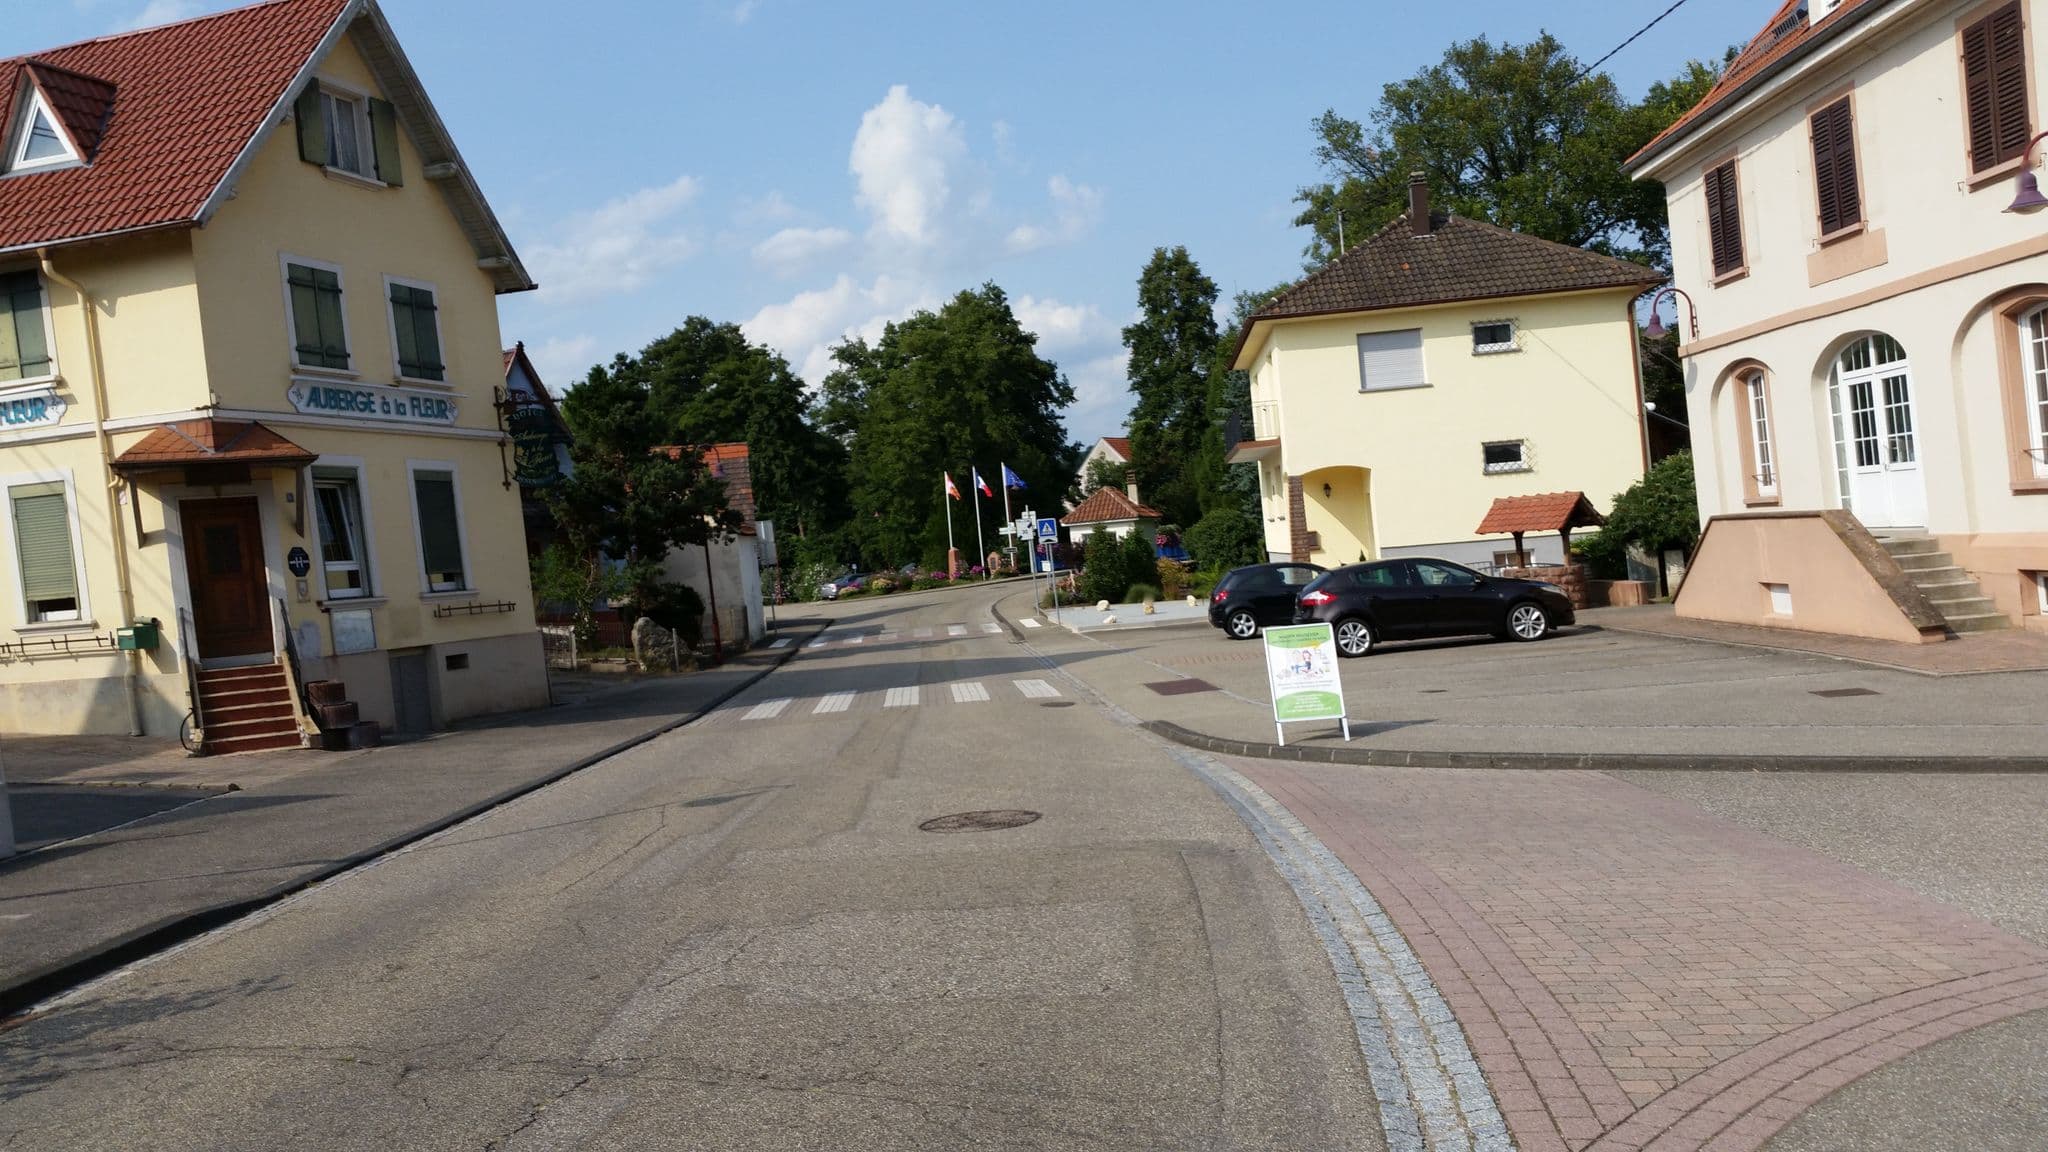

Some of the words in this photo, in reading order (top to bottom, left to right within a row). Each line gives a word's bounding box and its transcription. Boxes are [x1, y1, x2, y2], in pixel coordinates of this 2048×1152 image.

[306, 386, 377, 414] AUBERGE
[381, 396, 391, 414] à
[394, 398, 407, 416] la
[410, 396, 449, 419] FLEUR
